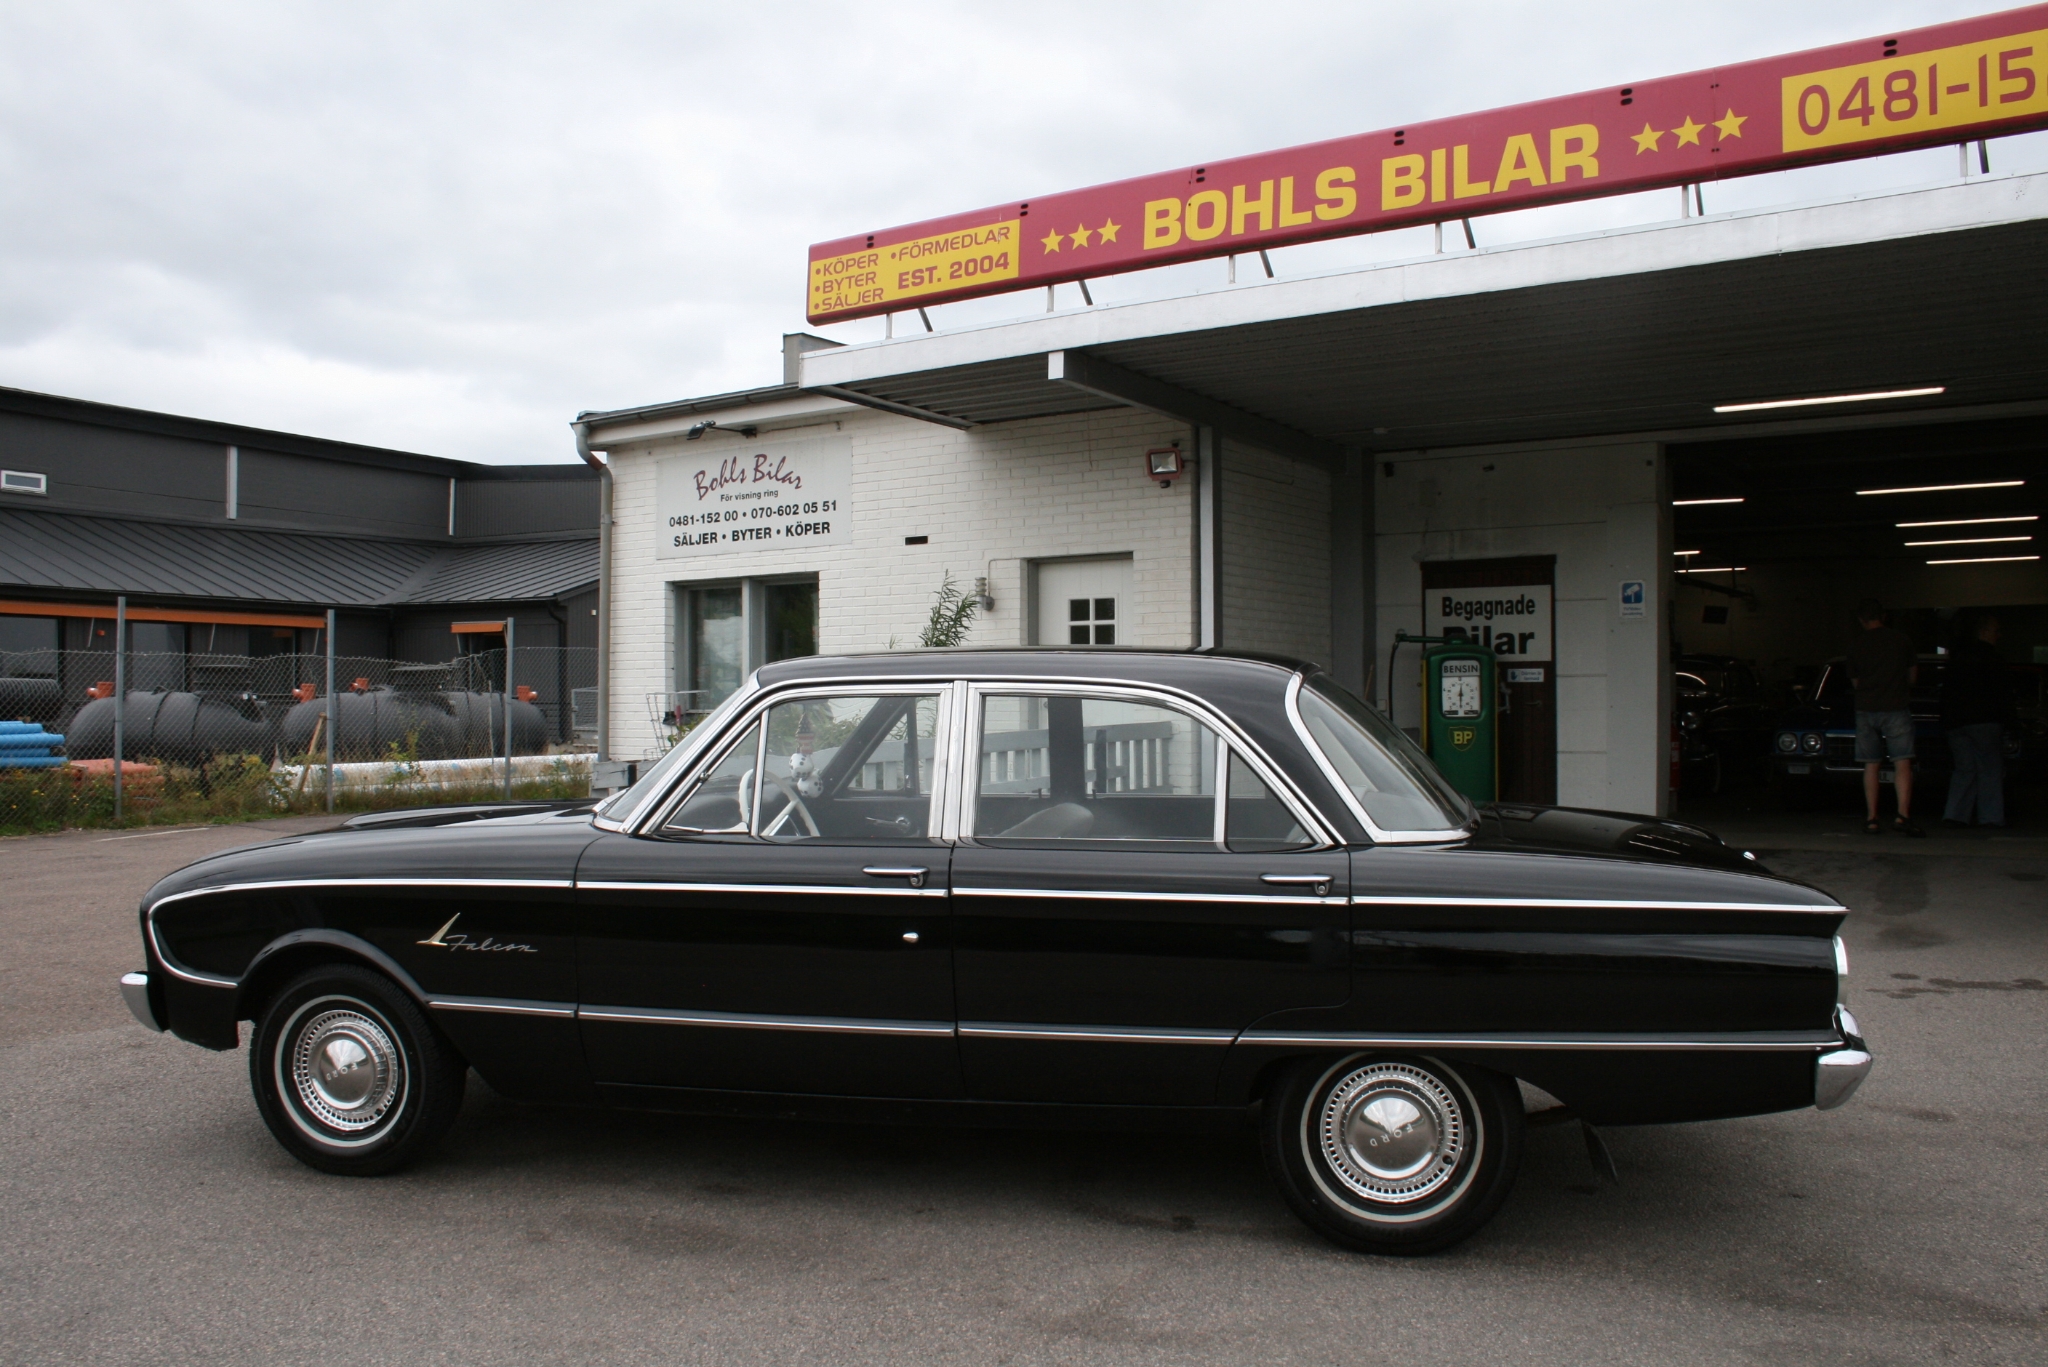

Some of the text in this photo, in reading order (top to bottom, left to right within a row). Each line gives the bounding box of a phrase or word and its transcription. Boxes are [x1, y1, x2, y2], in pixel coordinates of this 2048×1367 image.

[1797, 46, 2048, 136] 0481-15
[1142, 122, 1600, 250] BOHLS BILAR
[822, 225, 1011, 277] KÖPER FÖRMEDLAR
[821, 252, 1011, 295] BYTER EST. 2004
[821, 286, 885, 312] SÄLJER
[692, 453, 803, 501] Bohls Bilar
[720, 488, 779, 502] För visning ring
[668, 499, 838, 528] 0481-152 00 070-602 05 51
[673, 520, 831, 548] SÄLJER BYTER KÖPER
[1441, 593, 1536, 621] Begagnade
[1443, 664, 1479, 674] BENSIN
[1452, 730, 1473, 745] BP
[445, 934, 539, 952] Falcon
[1369, 1122, 1414, 1147] FORD
